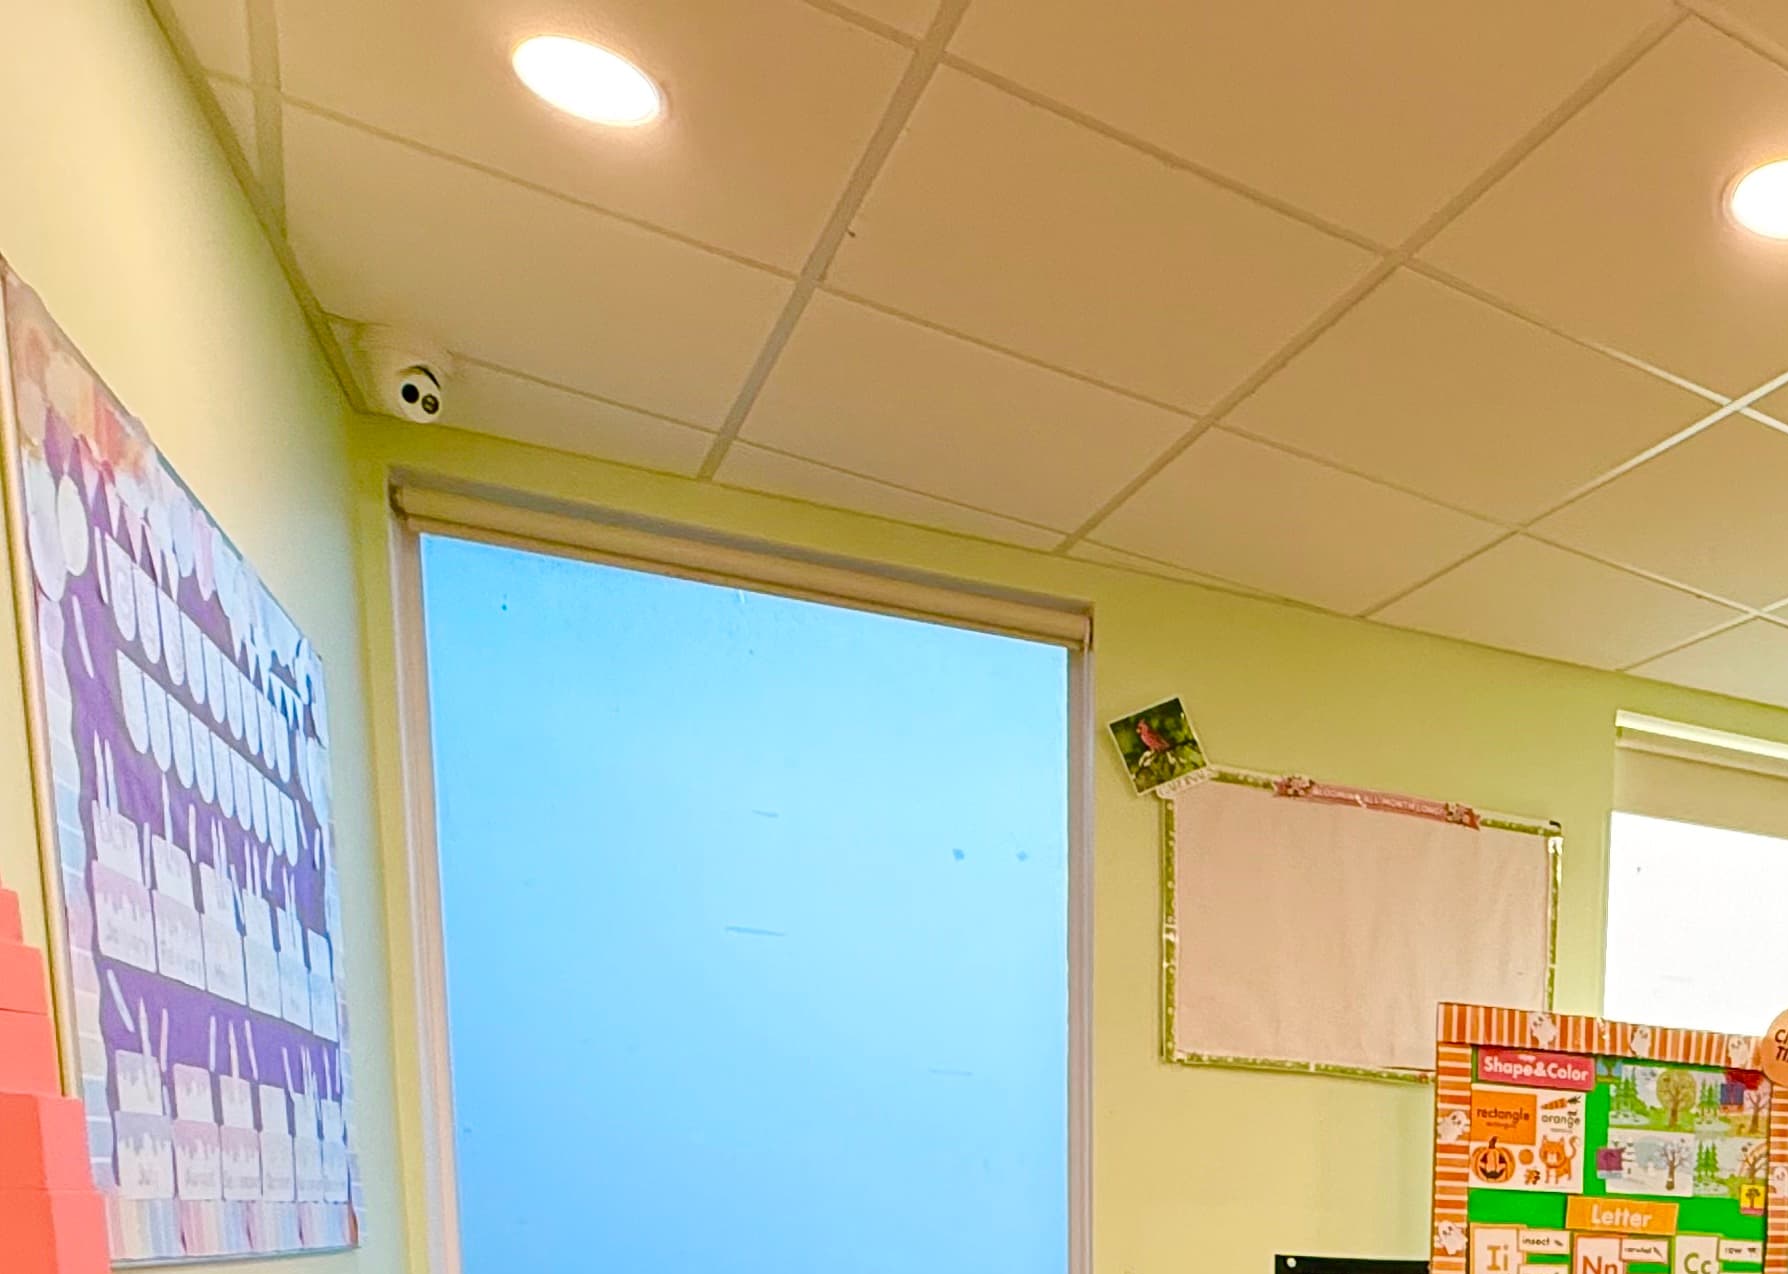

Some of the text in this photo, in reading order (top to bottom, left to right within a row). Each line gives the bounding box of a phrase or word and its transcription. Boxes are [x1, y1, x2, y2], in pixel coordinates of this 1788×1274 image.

[1484, 1056, 1589, 1081] Shape&Color
[1477, 1108, 1530, 1125] rectangle
[1541, 1110, 1580, 1129] orange
[1591, 1204, 1653, 1228] Letter
[1522, 1237, 1550, 1246] insect
[1486, 1244, 1509, 1272] Ii
